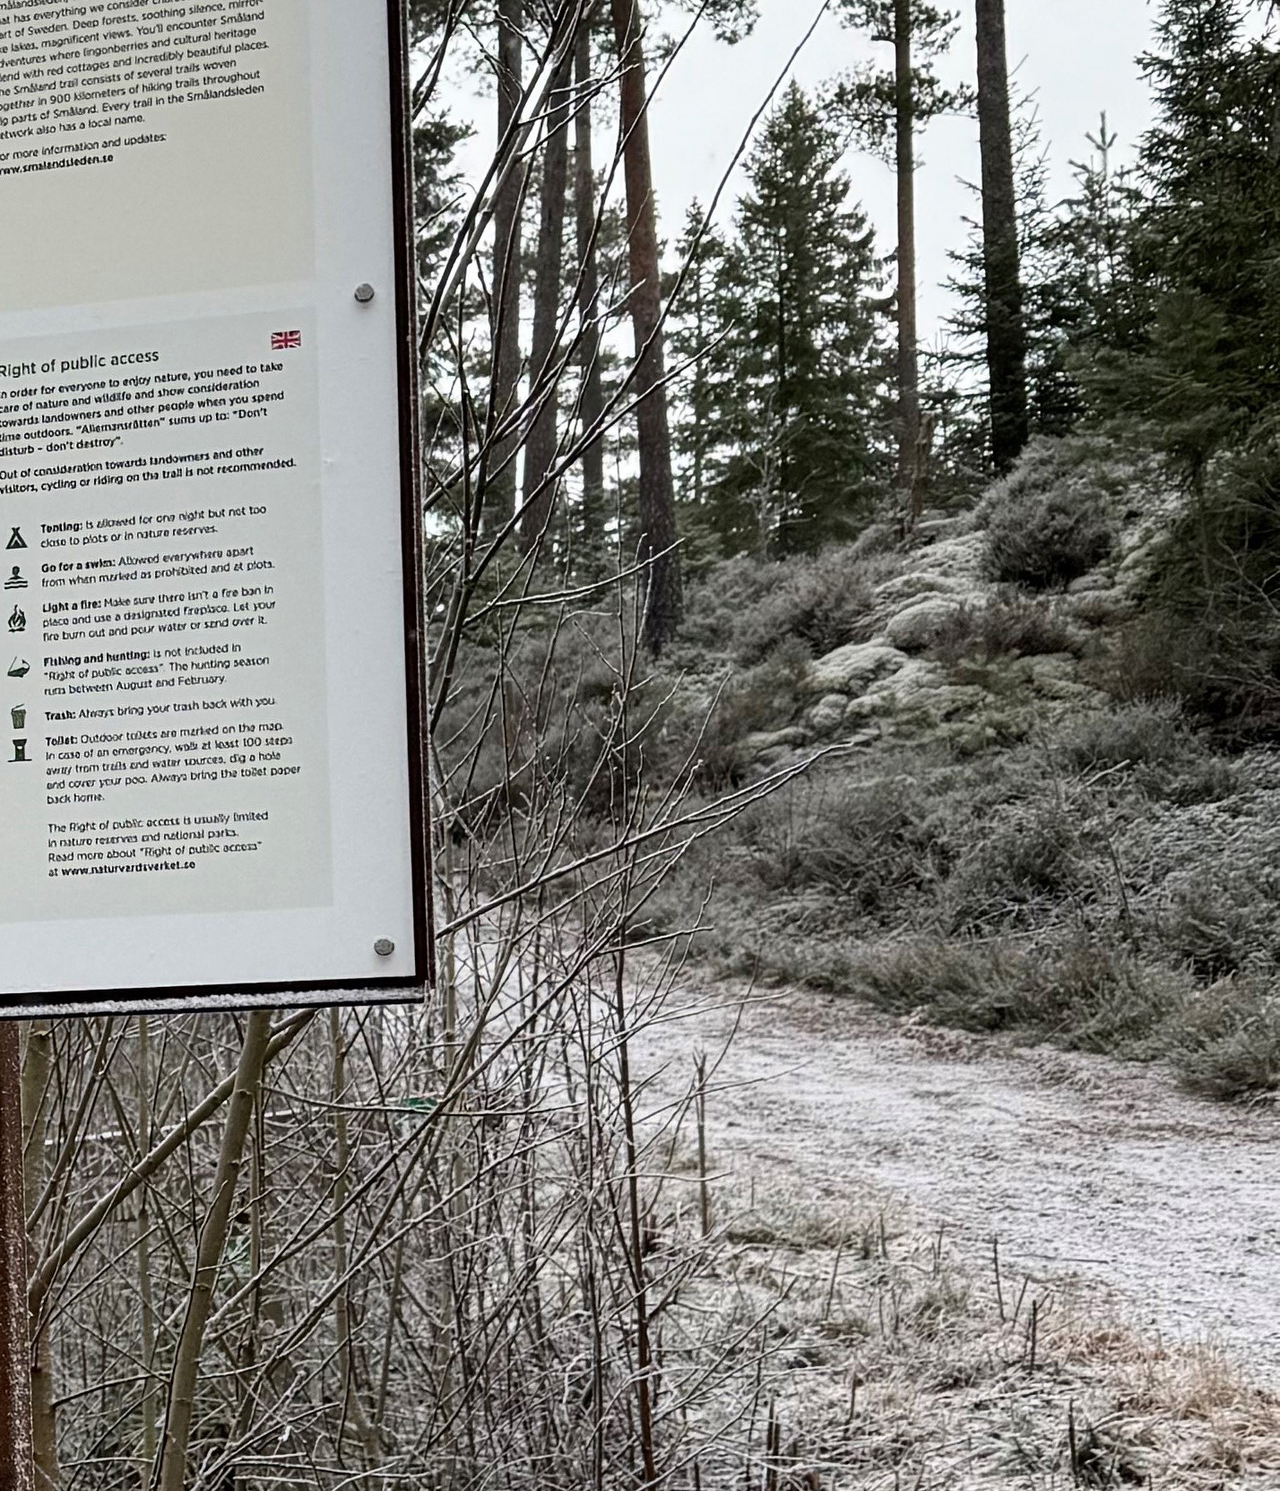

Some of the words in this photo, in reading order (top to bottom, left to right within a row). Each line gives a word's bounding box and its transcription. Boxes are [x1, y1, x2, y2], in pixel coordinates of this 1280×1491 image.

[14, 14, 30, 22] has
[33, 7, 86, 20] everything
[89, 4, 104, 12] we
[15, 27, 24, 37] of
[73, 19, 99, 29] Deep
[142, 8, 185, 20] soothing
[41, 32, 99, 47] magnificent
[166, 18, 216, 31] encounter
[220, 10, 264, 25] Småland
[50, 50, 80, 60] where
[83, 41, 148, 57] lingonberries
[151, 37, 170, 48] and
[173, 32, 211, 45] cultural
[214, 28, 256, 39] heritage
[23, 68, 43, 78] with
[47, 65, 63, 75] red
[66, 61, 109, 73] cottages
[113, 56, 131, 67] and
[135, 50, 183, 64] incredibly
[187, 44, 231, 58] beautiful
[13, 149, 38, 159] more
[42, 141, 98, 155] information
[101, 137, 121, 148] and
[41, 359, 55, 372] of
[61, 355, 105, 373] public
[111, 351, 158, 365] access
[10, 387, 37, 397] order
[41, 385, 55, 394] for
[58, 381, 105, 392] everyone
[109, 379, 119, 387] to
[122, 375, 150, 386] enjoy
[194, 370, 213, 380] you
[217, 365, 242, 376] need
[246, 365, 256, 373] to
[260, 362, 283, 372] take
[22, 401, 32, 411] of
[36, 399, 68, 409] nature
[72, 396, 90, 406] and
[94, 391, 131, 403] wildlife
[135, 388, 154, 399] and
[158, 388, 184, 397] show
[188, 379, 259, 394] consideration
[42, 411, 101, 423] landowners
[104, 406, 123, 417] and
[127, 405, 154, 414] other
[158, 400, 194, 413] people
[198, 398, 226, 407] when
[229, 396, 248, 406] you
[252, 391, 284, 403] spend
[45, 710, 76, 720] Trash:
[117, 706, 143, 715] bring
[147, 704, 169, 715] your
[173, 701, 199, 711] trash
[202, 699, 226, 709] back
[230, 697, 252, 707] with
[49, 868, 57, 876] at
